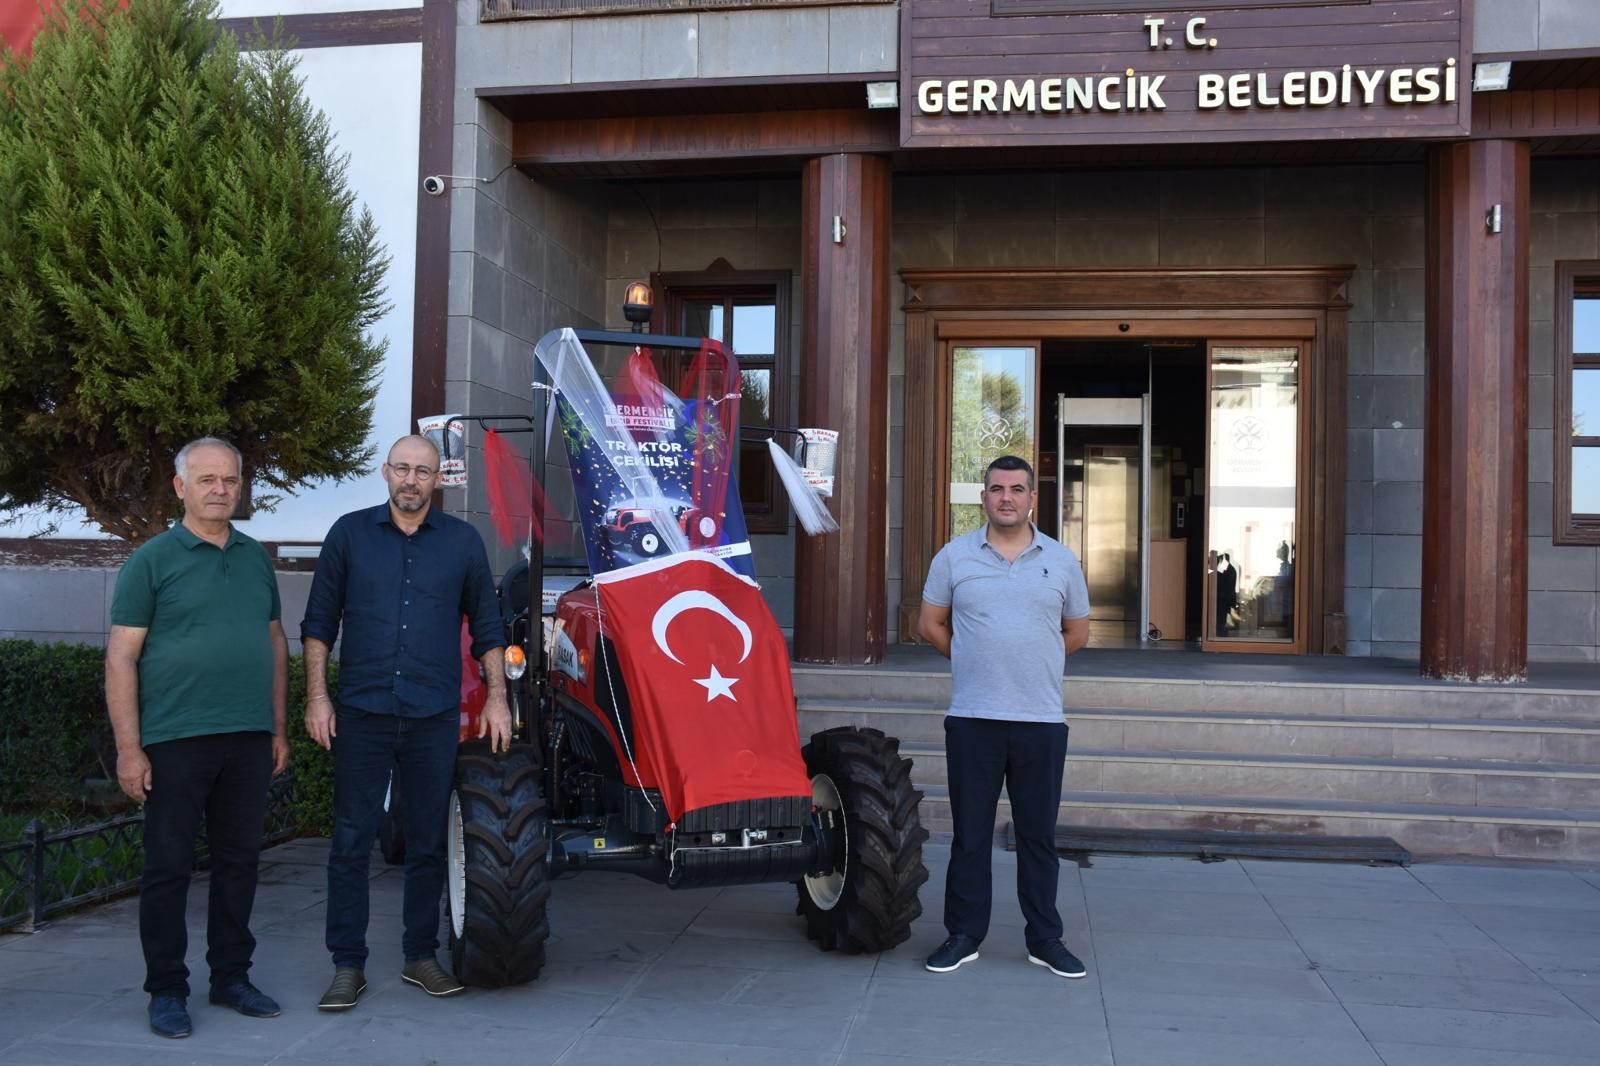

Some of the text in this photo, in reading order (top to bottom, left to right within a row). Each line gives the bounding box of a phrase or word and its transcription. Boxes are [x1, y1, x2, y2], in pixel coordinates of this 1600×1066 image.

[1144, 17, 1218, 47] T. C.
[918, 57, 1456, 113] GERMENCİK BELEDİYESİ
[607, 404, 675, 418] ERMENCİK
[605, 440, 682, 453] TRKTÖR
